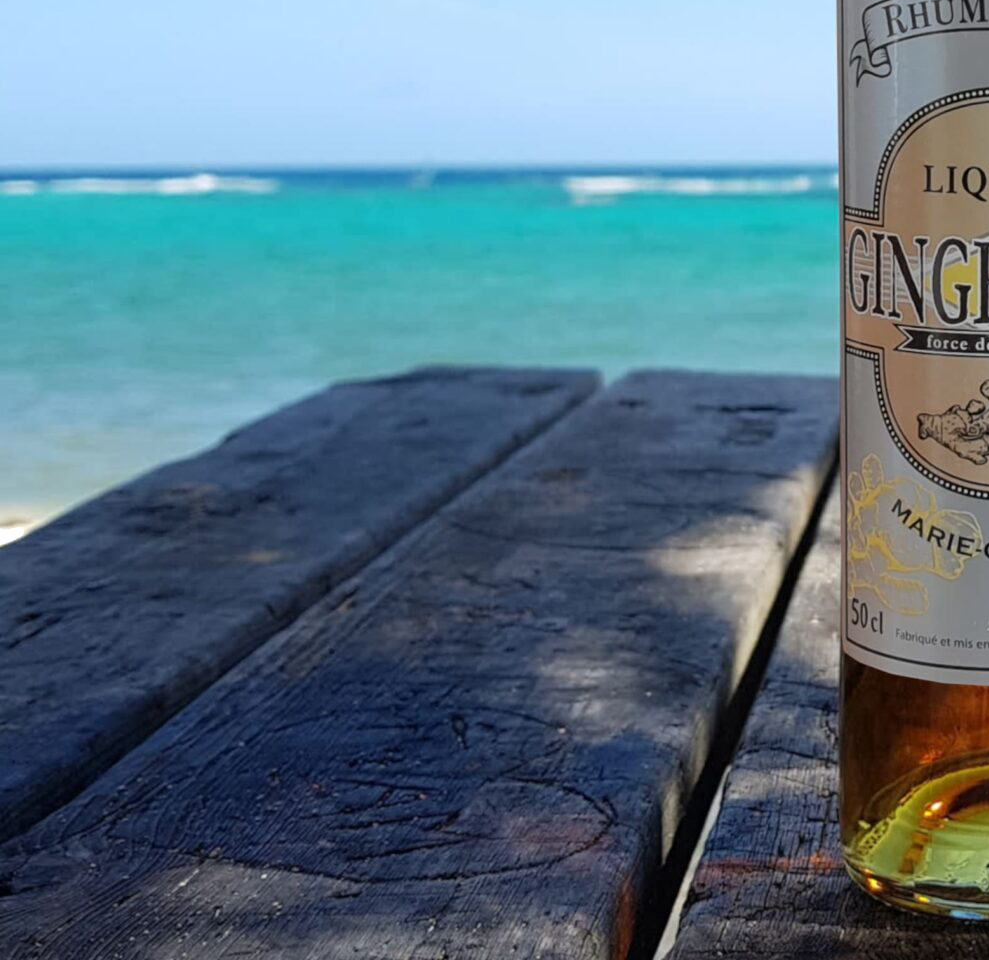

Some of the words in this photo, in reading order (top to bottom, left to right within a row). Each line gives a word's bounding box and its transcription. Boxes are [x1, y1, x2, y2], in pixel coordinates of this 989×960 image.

[926, 334, 968, 350] force
[895, 628, 937, 646] Fabriqué
[940, 637, 950, 647] et
[953, 637, 973, 649] mis
